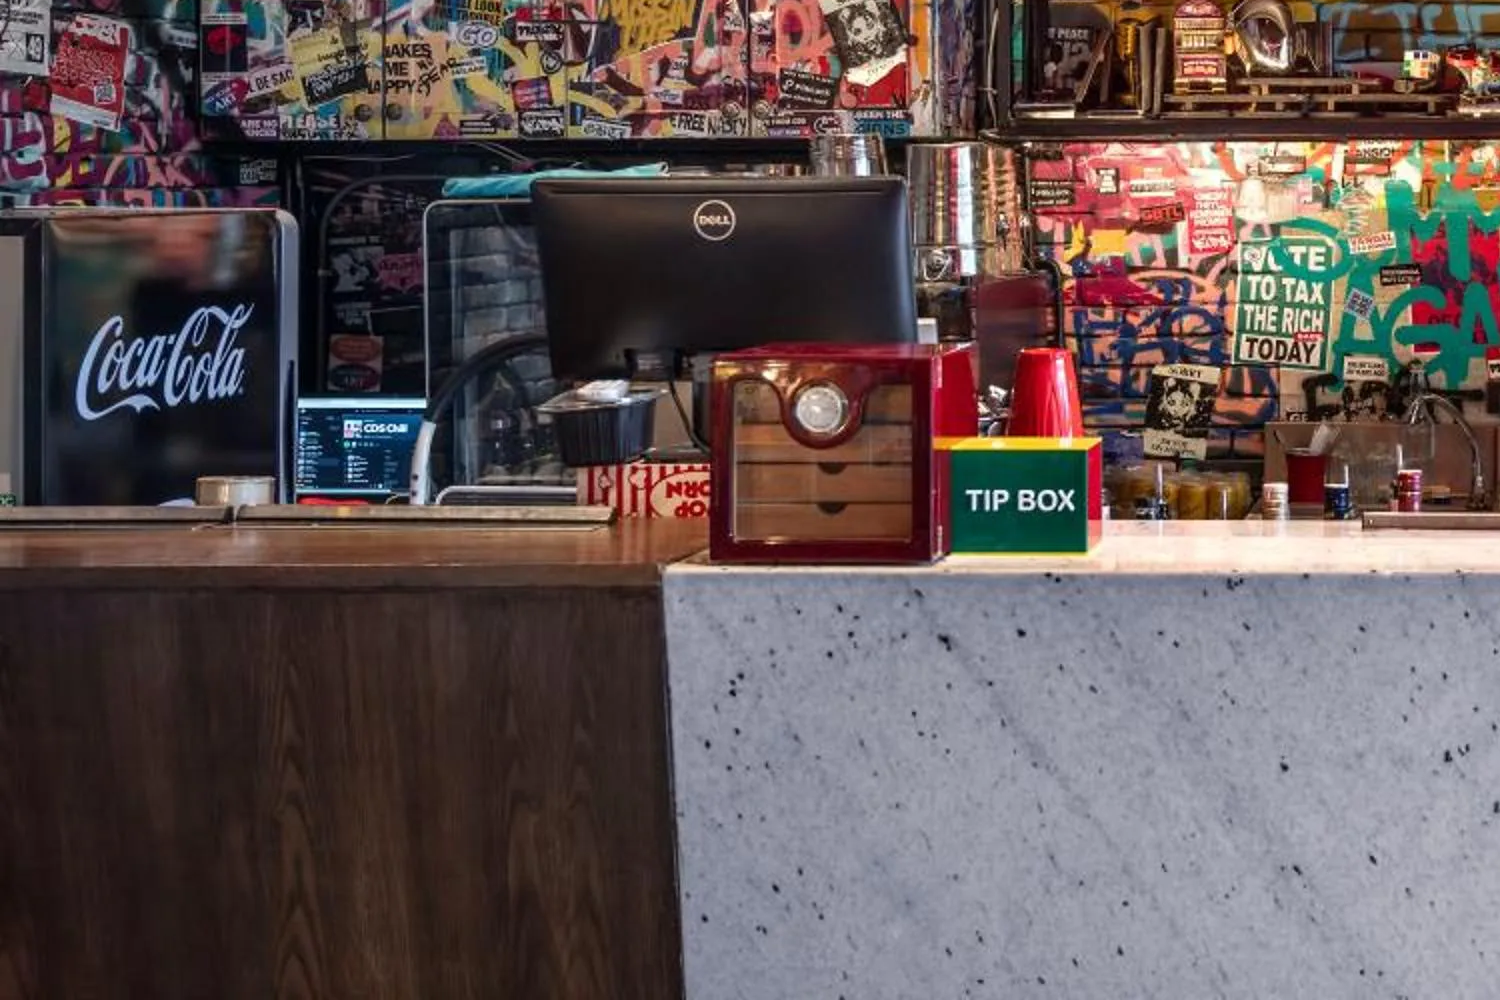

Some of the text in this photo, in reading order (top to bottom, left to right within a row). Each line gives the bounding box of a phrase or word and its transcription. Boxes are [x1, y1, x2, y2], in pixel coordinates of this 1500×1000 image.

[677, 113, 705, 131] FREE
[699, 214, 732, 227] DELL
[1246, 275, 1325, 305] TO TAX
[1243, 303, 1325, 334] THE RICH
[1245, 336, 1316, 365] TODAY
[964, 489, 1076, 512] TIP BOX
